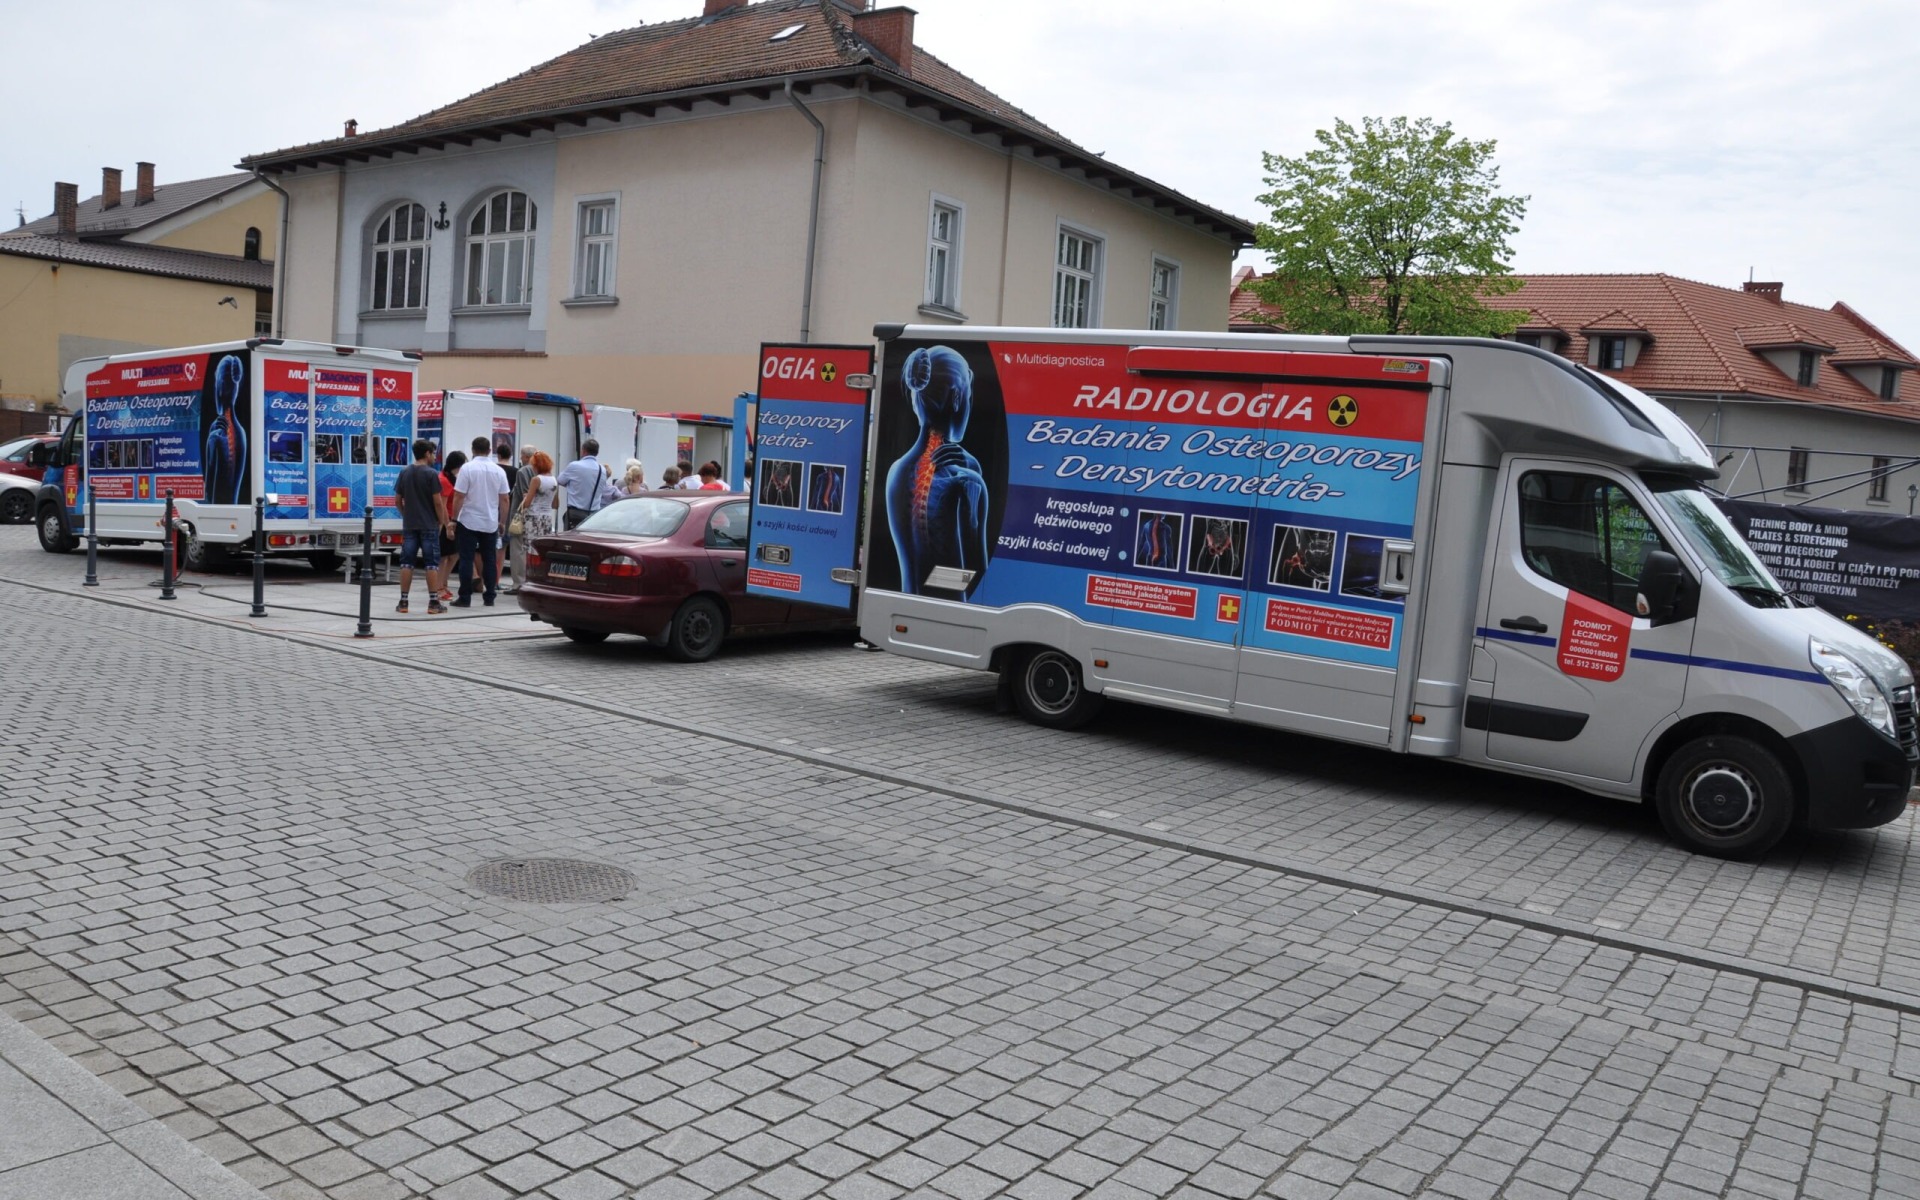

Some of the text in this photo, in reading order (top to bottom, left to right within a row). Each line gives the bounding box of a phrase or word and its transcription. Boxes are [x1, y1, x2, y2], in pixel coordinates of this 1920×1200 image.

[762, 356, 815, 380] OGIA
[1016, 353, 1105, 367] Multidiagnostica
[87, 394, 196, 412] Badania Osteoporozy
[1073, 385, 1313, 421] RADIOLOGIA
[1025, 419, 1421, 481] Badania Osteoporozy
[1046, 497, 1115, 517] kręgosłupa
[763, 520, 837, 538] szyjki kości udowej
[1033, 513, 1112, 535] lędźwiowego
[1750, 518, 1848, 536] TRENING BODY & MIND
[1748, 529, 1848, 548] PILATES & STRETCHING
[997, 535, 1111, 561] szyjki kości udowej
[1785, 545, 1838, 558] KRĘGOSŁUP
[1784, 556, 1801, 567] DLA
[1803, 559, 1836, 570] KOBIET
[1838, 562, 1846, 572] W
[1848, 562, 1875, 576] CIĄŻY
[1877, 566, 1881, 575] I
[1883, 566, 1897, 577] PO
[1899, 568, 1920, 579] POR
[1095, 578, 1191, 597] Pracownia posiada system
[1812, 571, 1842, 583] DZIECI
[1843, 574, 1848, 584] I
[1849, 575, 1900, 589] MŁODZIEŻY
[1094, 585, 1169, 601] zarządzania jakością
[1800, 582, 1857, 597] KOREKCYJNA
[1092, 594, 1176, 612] Gwarantujemy zaufanie
[1271, 618, 1389, 644] PODMIOT LECZNICZY
[1573, 619, 1612, 632] PODMIOT
[1572, 630, 1618, 643] LECZNICZY
[1576, 660, 1589, 668] 512
[1590, 662, 1603, 670] 351
[1605, 664, 1618, 673] 600
